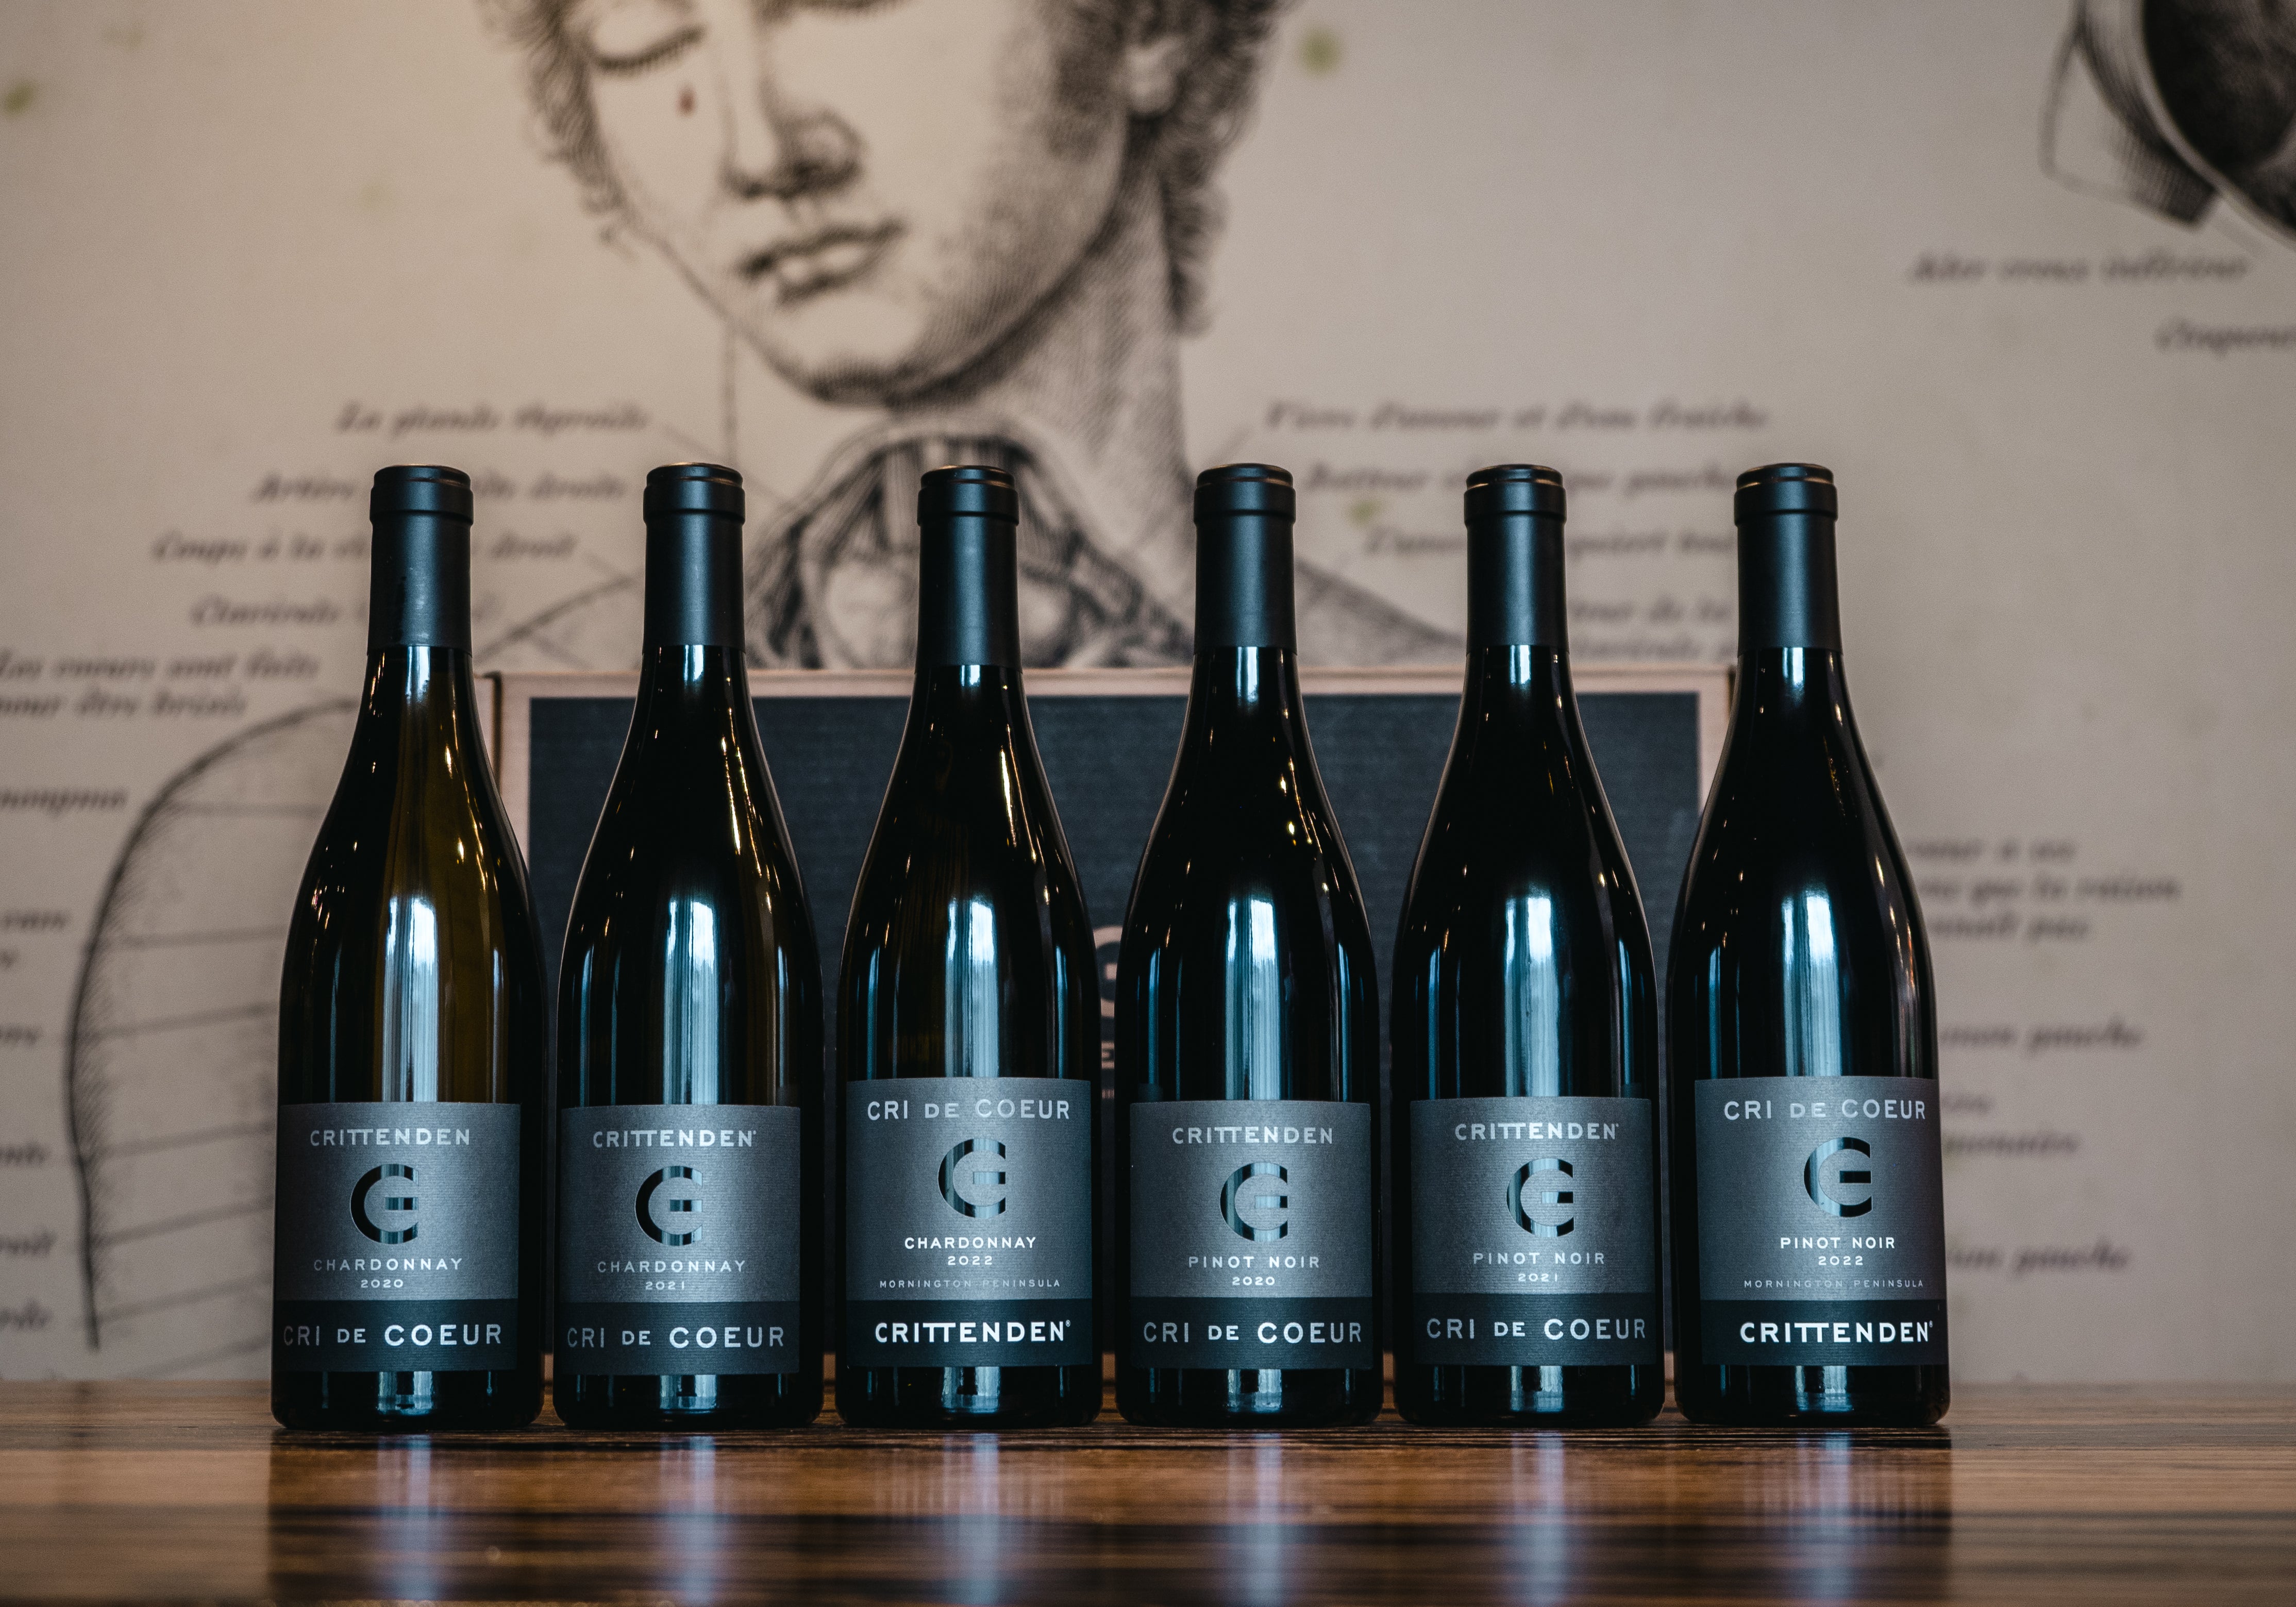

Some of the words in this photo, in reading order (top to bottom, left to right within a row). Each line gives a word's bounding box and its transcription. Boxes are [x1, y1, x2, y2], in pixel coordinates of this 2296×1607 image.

[867, 1100, 909, 1120] CRI
[925, 1103, 959, 1118] DE
[975, 1099, 1070, 1120] COEUR
[1724, 1100, 1771, 1120] CRI
[1790, 1102, 1825, 1118] DE
[1841, 1099, 1925, 1120] COEUR
[309, 1128, 470, 1146] CRITTENDEN
[1172, 1126, 1333, 1145] CRITTENDEN
[904, 1236, 1036, 1249] CHARDONNAY
[1780, 1237, 1841, 1249] PINOT
[1852, 1237, 1895, 1249] NOIR
[313, 1258, 463, 1271] CHARDONNAY
[947, 1256, 993, 1266] 2022
[1188, 1256, 1253, 1268] PINOT
[1269, 1256, 1320, 1268] NOIR
[1472, 1252, 1539, 1265] PINOT
[1554, 1253, 1605, 1265] NOIR
[1818, 1256, 1864, 1266] 2022
[597, 1261, 746, 1274] CHARDONNAY
[360, 1279, 404, 1288] 2020
[983, 1279, 1060, 1287] PENINSULA
[1232, 1276, 1276, 1285] 2020
[1517, 1273, 1558, 1282] 2021
[1744, 1280, 1843, 1288] MORNINGTON
[1853, 1280, 1923, 1288] PENINSULA
[645, 1281, 685, 1290] 2021
[283, 1325, 321, 1346] CRI
[337, 1328, 366, 1344] DE
[384, 1324, 501, 1346] COEUR
[1144, 1323, 1188, 1343] CRI
[1208, 1325, 1238, 1341] DE
[1258, 1321, 1362, 1344] COEUR
[1427, 1318, 1474, 1338] CRI
[1494, 1321, 1524, 1337] DE
[1544, 1317, 1646, 1340] COEUR
[567, 1328, 605, 1348] CRI
[622, 1331, 651, 1346] DE
[669, 1326, 784, 1349] COEUR
